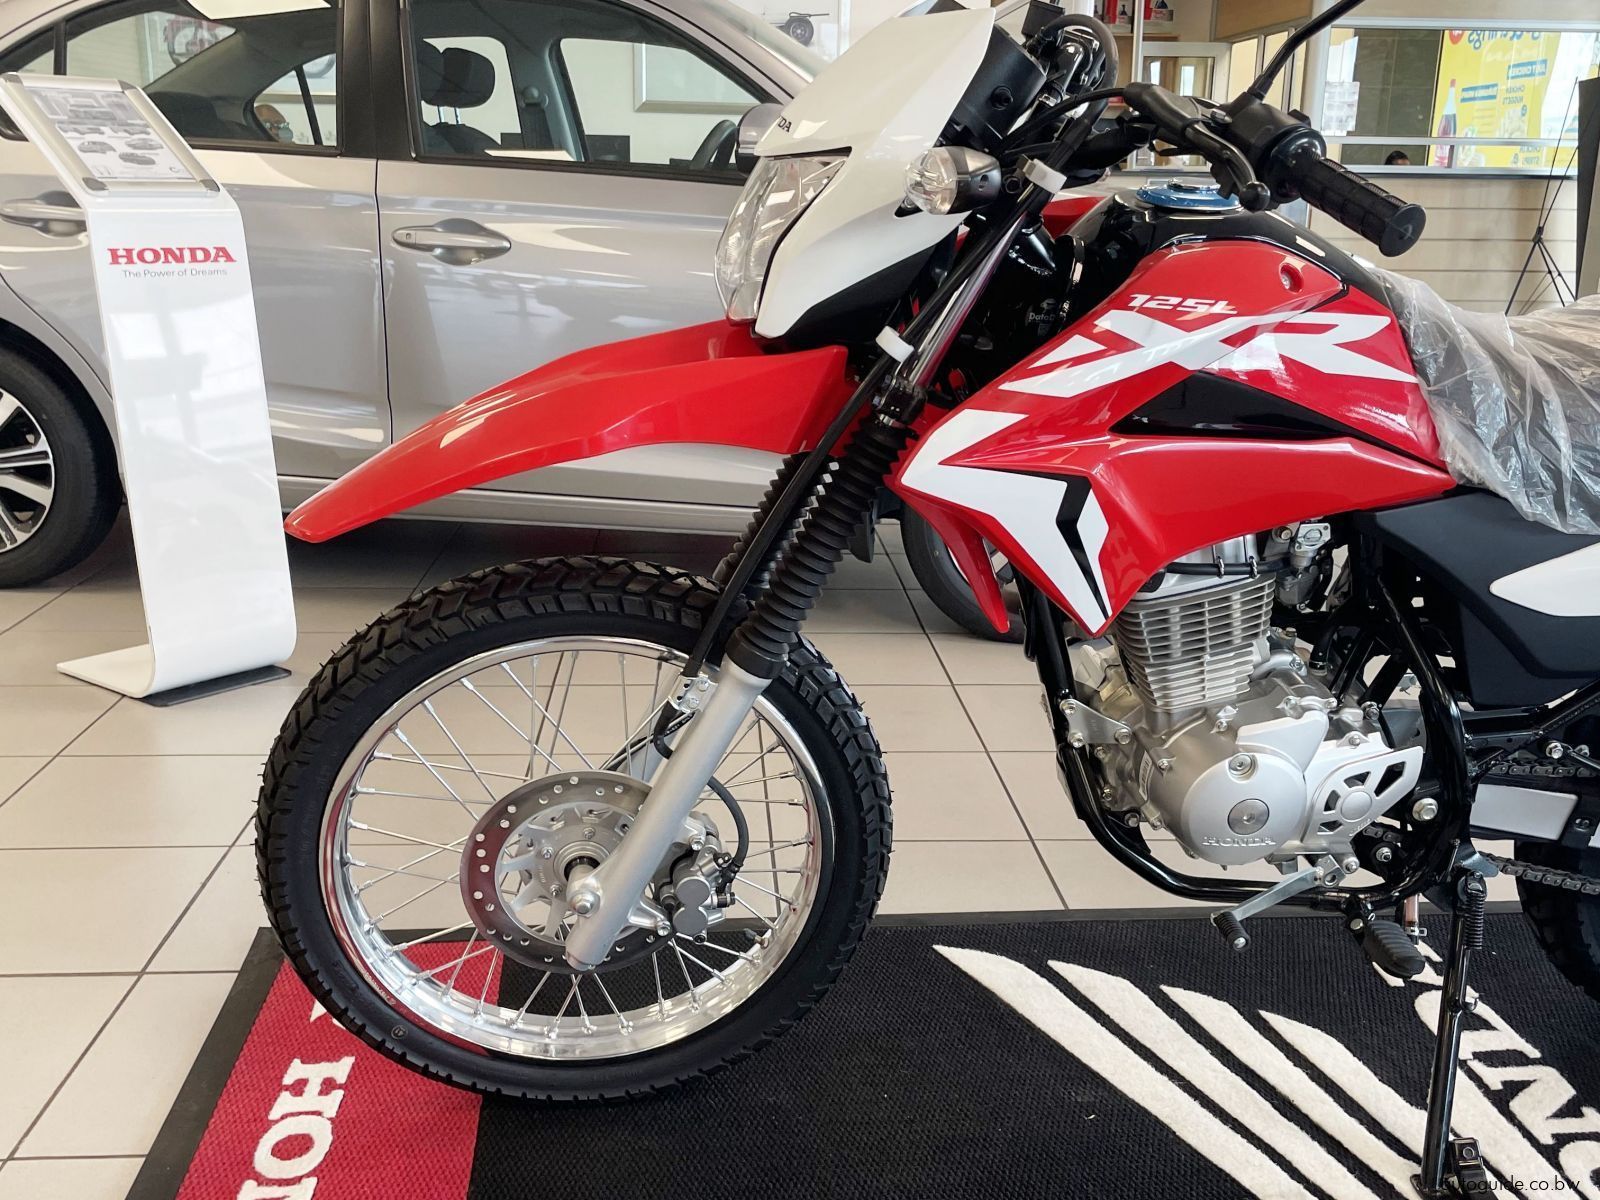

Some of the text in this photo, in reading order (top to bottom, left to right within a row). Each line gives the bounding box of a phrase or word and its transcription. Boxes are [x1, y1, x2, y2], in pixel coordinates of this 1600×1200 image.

[107, 246, 237, 264] HONDA
[123, 268, 228, 278] The Power of Dreams
[1128, 294, 1238, 315] 125L
[998, 310, 1418, 398] XR
[1202, 836, 1277, 847] HONDA
